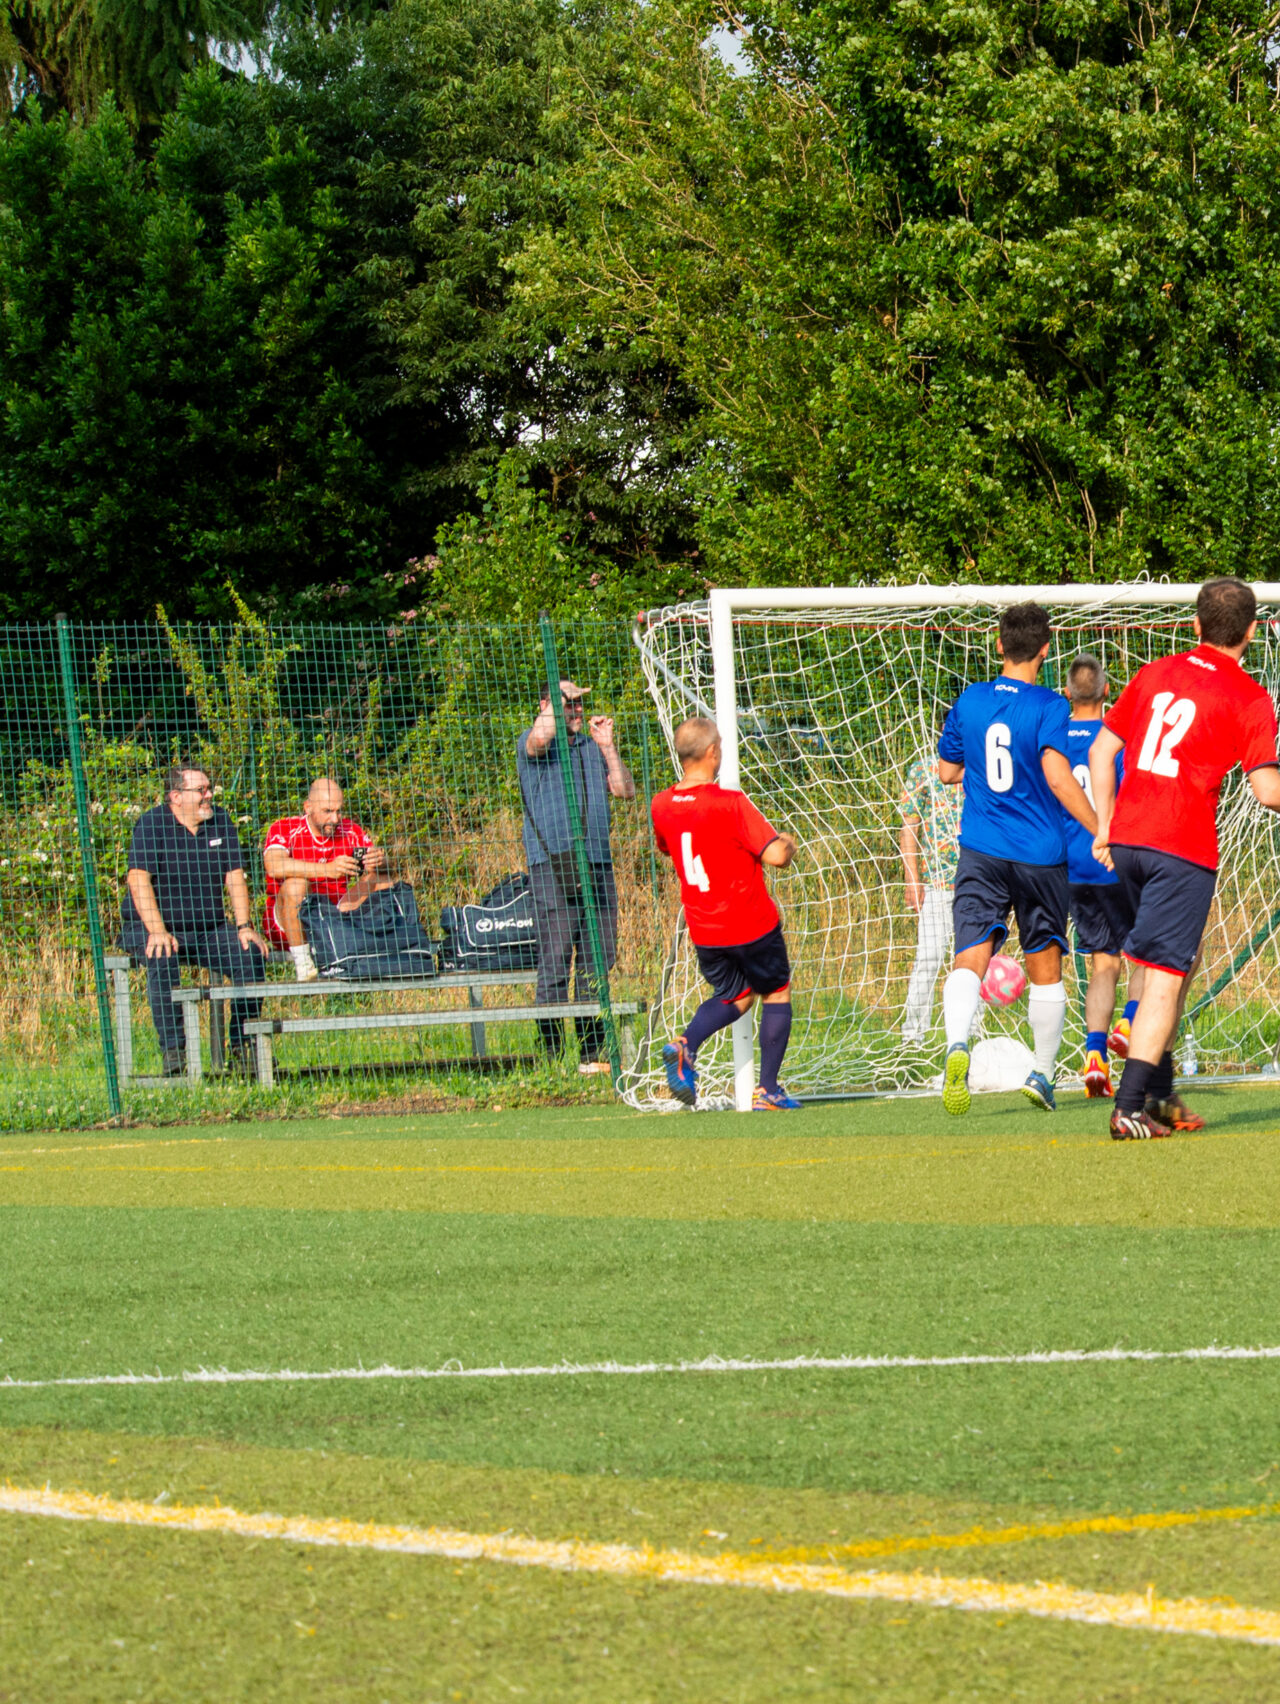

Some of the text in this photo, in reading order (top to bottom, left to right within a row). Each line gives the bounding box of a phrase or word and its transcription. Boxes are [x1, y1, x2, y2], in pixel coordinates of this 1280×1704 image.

[986, 722, 1014, 793] 6
[1137, 692, 1196, 778] 12
[681, 832, 710, 892] 4
